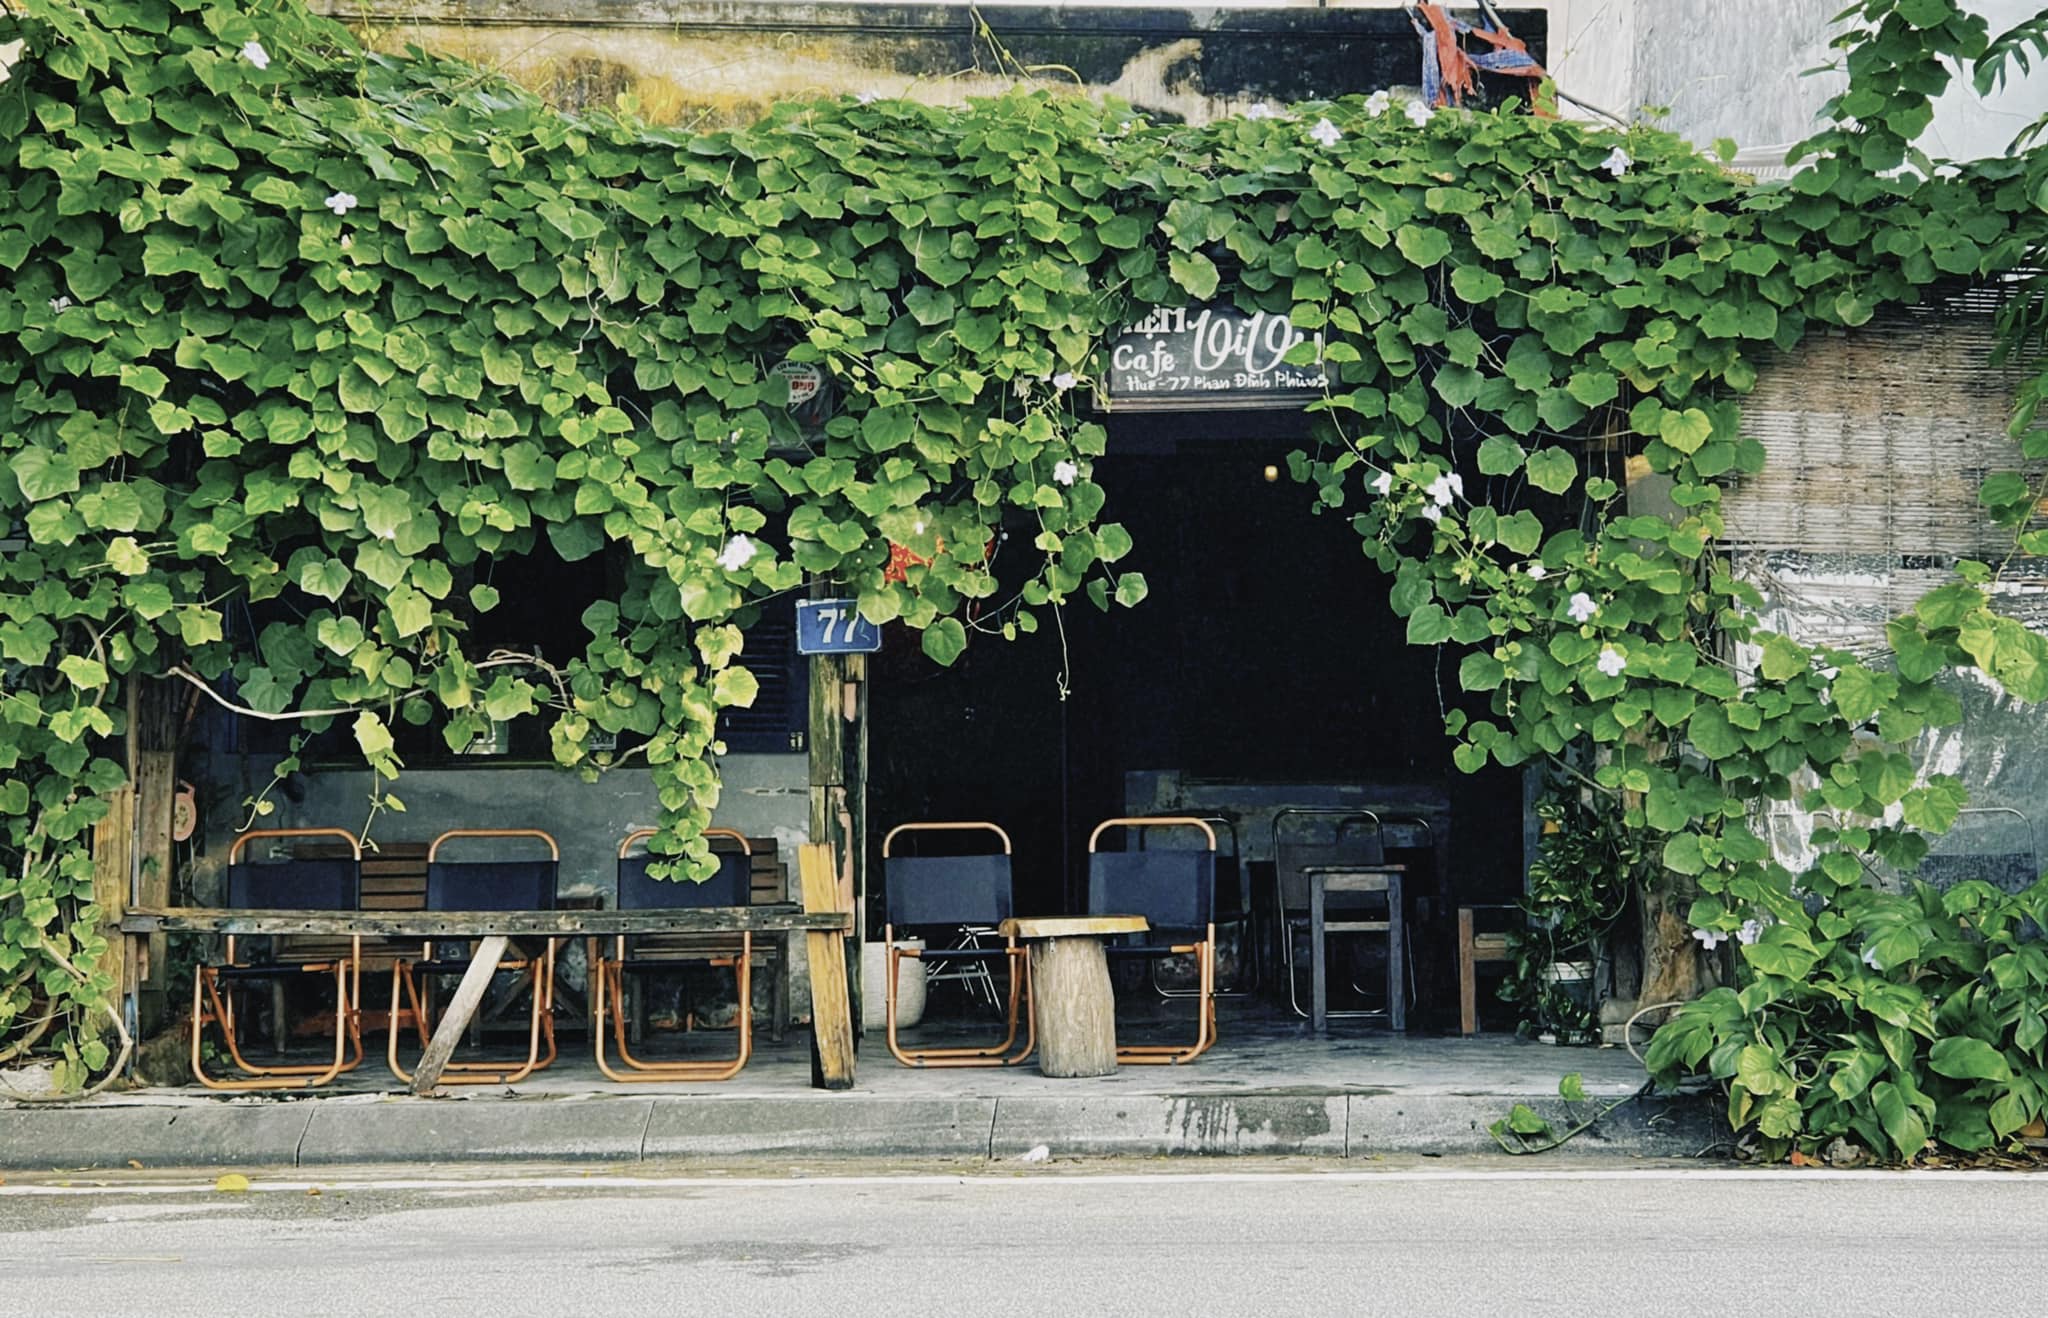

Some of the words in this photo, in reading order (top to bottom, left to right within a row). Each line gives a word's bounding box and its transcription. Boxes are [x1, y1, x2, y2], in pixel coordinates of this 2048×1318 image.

[1113, 340, 1175, 378] Cafe
[1193, 375, 1231, 390] Phan
[818, 608, 859, 643] 77
